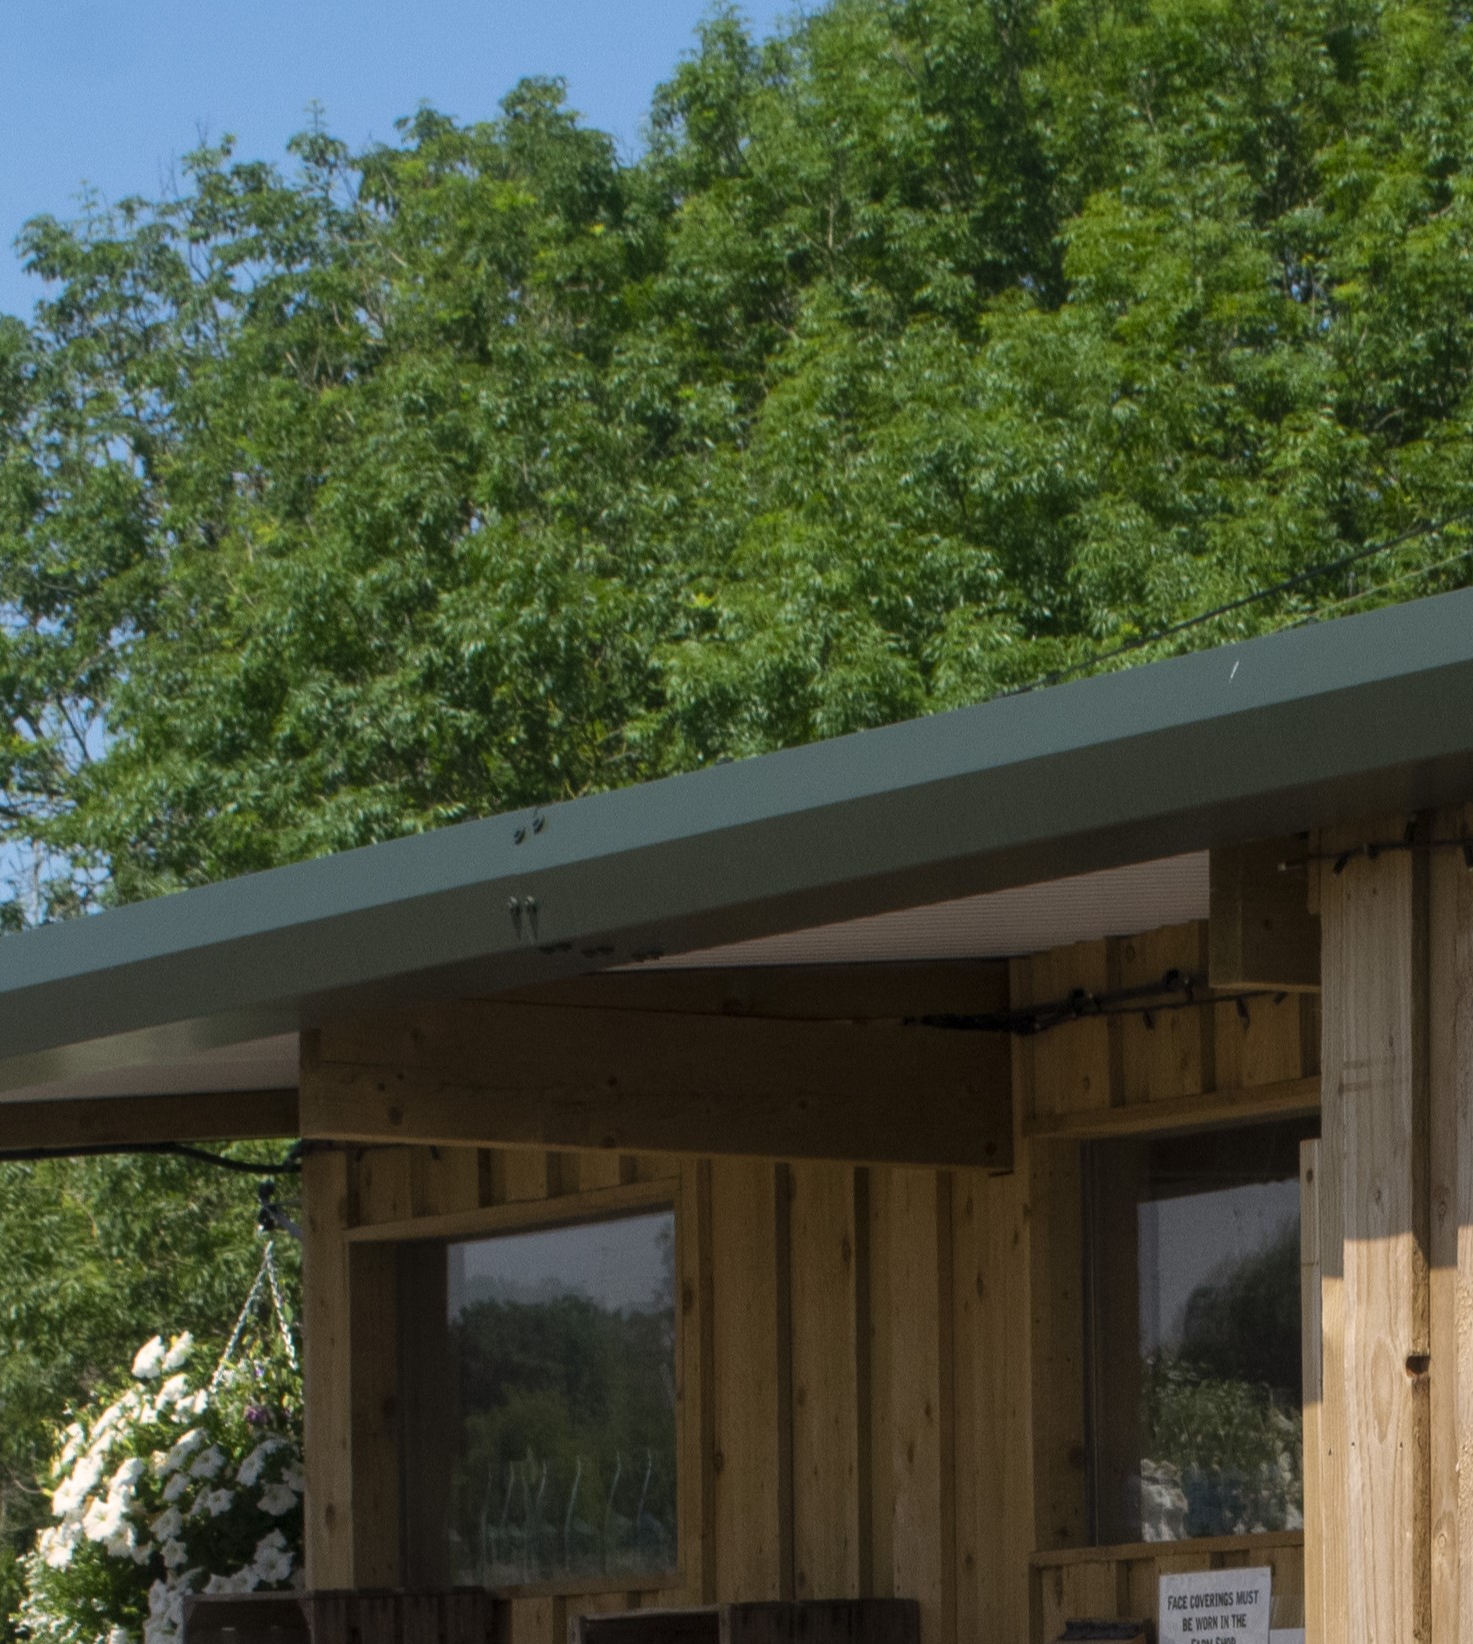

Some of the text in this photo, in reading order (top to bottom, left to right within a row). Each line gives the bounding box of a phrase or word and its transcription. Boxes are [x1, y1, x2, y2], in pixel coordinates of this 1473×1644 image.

[1167, 1590, 1259, 1611] FACE COVERINGS MUST
[1182, 1613, 1247, 1632] BE WORN IN THE
